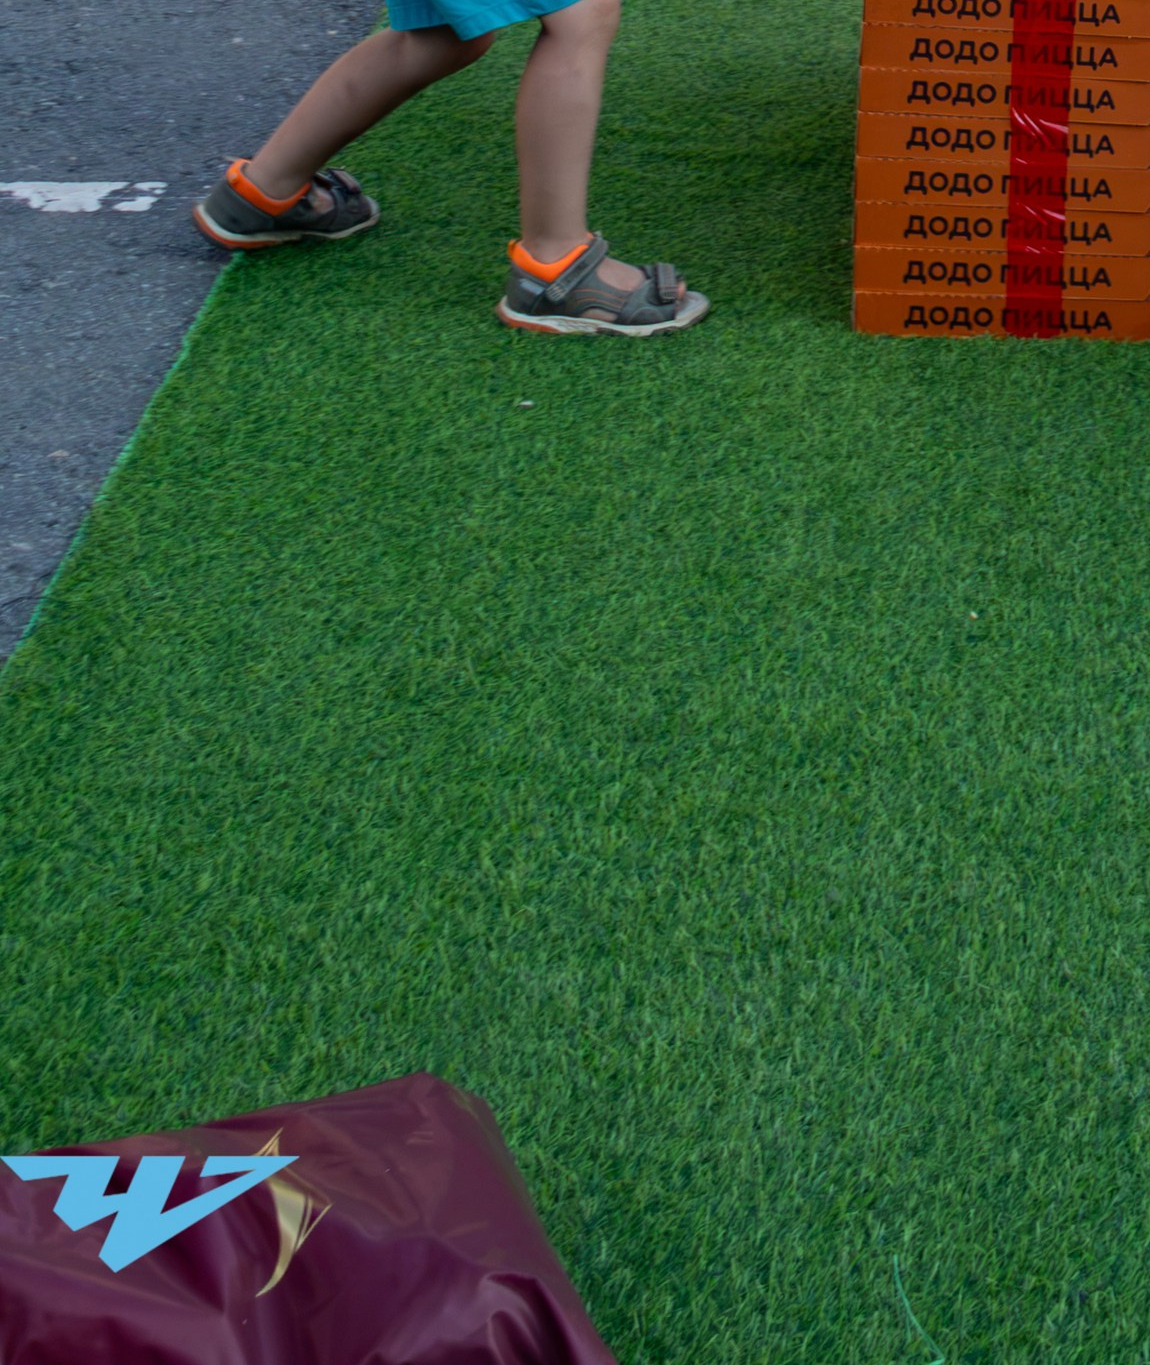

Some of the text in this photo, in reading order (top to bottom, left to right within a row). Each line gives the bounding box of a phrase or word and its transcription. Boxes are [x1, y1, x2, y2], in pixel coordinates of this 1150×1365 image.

[909, 37, 1118, 70] ДОДО ПИЦЦА
[907, 80, 1116, 113] ДОДО ПИЦЦА
[906, 126, 996, 153] ДОДО
[904, 170, 1113, 202] ДОДО ПИЦЦА
[903, 214, 993, 241] ДОДО
[902, 260, 1112, 291] ДОДО ПИЦЦА
[904, 305, 1113, 334] ДОДО ПИЦЦА
